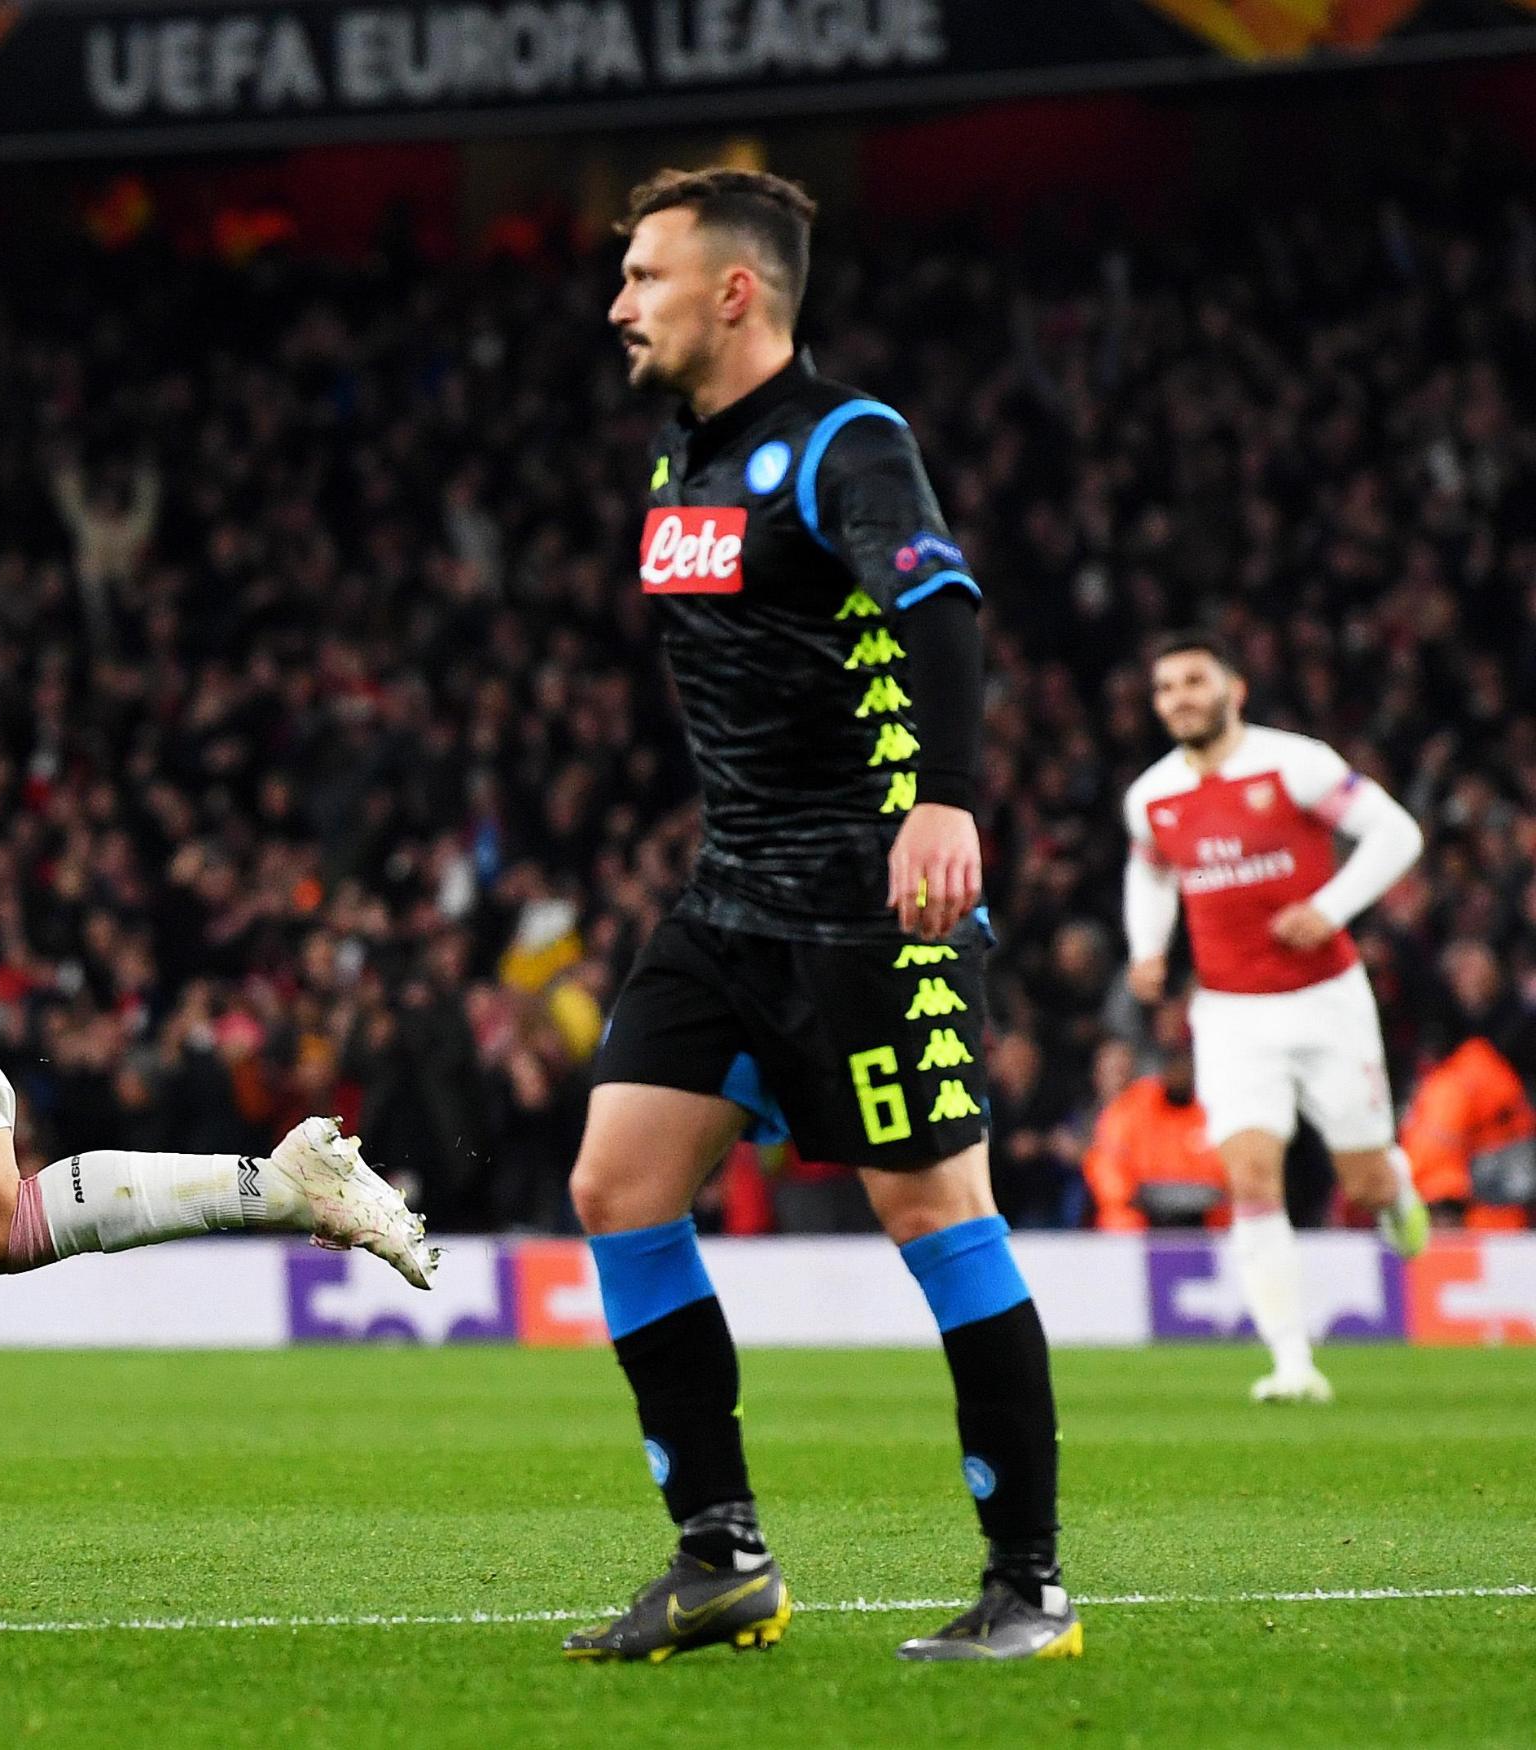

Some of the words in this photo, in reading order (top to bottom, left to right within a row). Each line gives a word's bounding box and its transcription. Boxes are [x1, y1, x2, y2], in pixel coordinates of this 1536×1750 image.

[85, 20, 325, 116] UEFA
[334, 5, 645, 104] EUROPA
[653, 0, 944, 79] LEAGUE
[640, 515, 742, 585] Lete
[849, 1046, 911, 1144] 6
